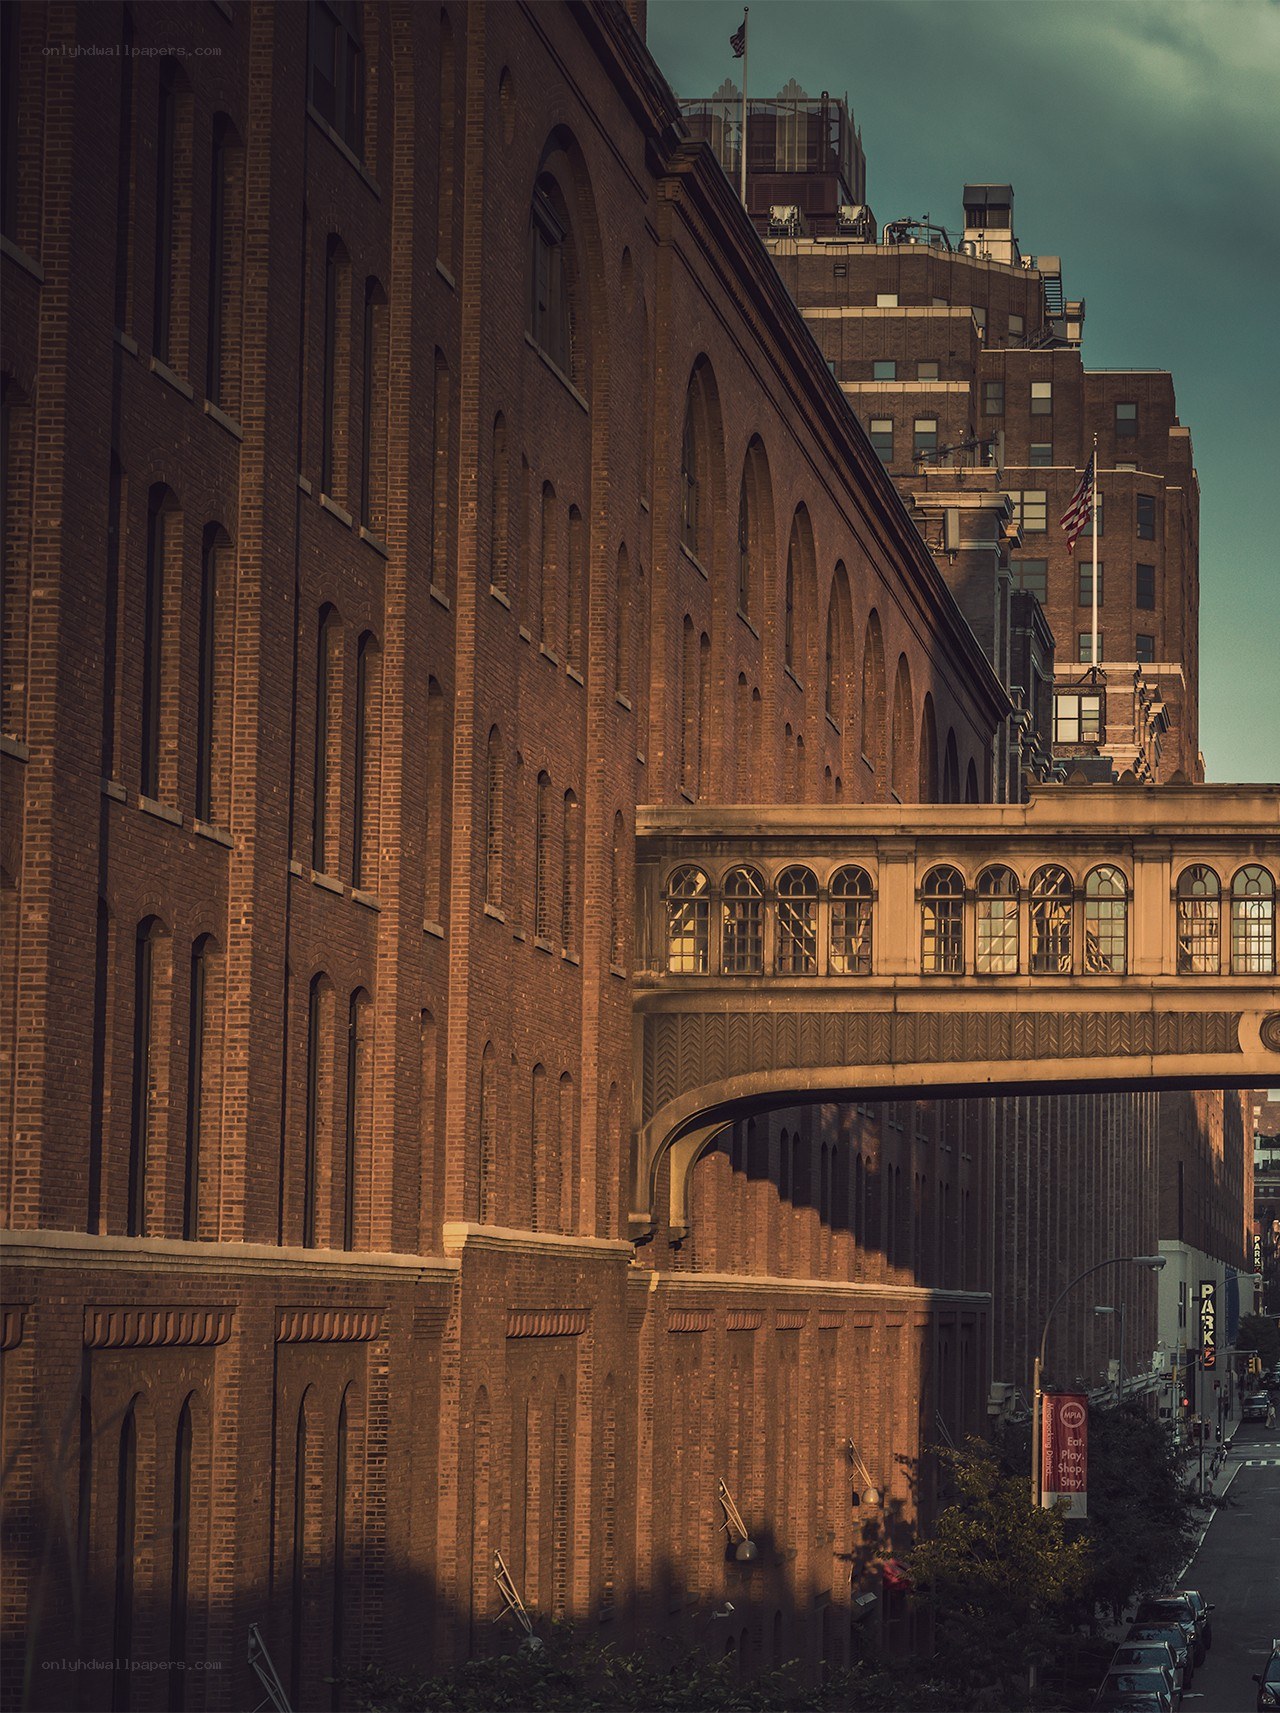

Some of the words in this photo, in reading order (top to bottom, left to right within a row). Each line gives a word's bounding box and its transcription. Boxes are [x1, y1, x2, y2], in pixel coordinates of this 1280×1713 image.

[1253, 1235, 1261, 1265] PARK
[1201, 1283, 1215, 1346] PARK
[1063, 1411, 1082, 1419] MPIA
[1067, 1436, 1085, 1447] Eat.
[1061, 1449, 1085, 1463] Play.
[1058, 1463, 1084, 1476] Shop.
[1060, 1476, 1085, 1489] Stay.
